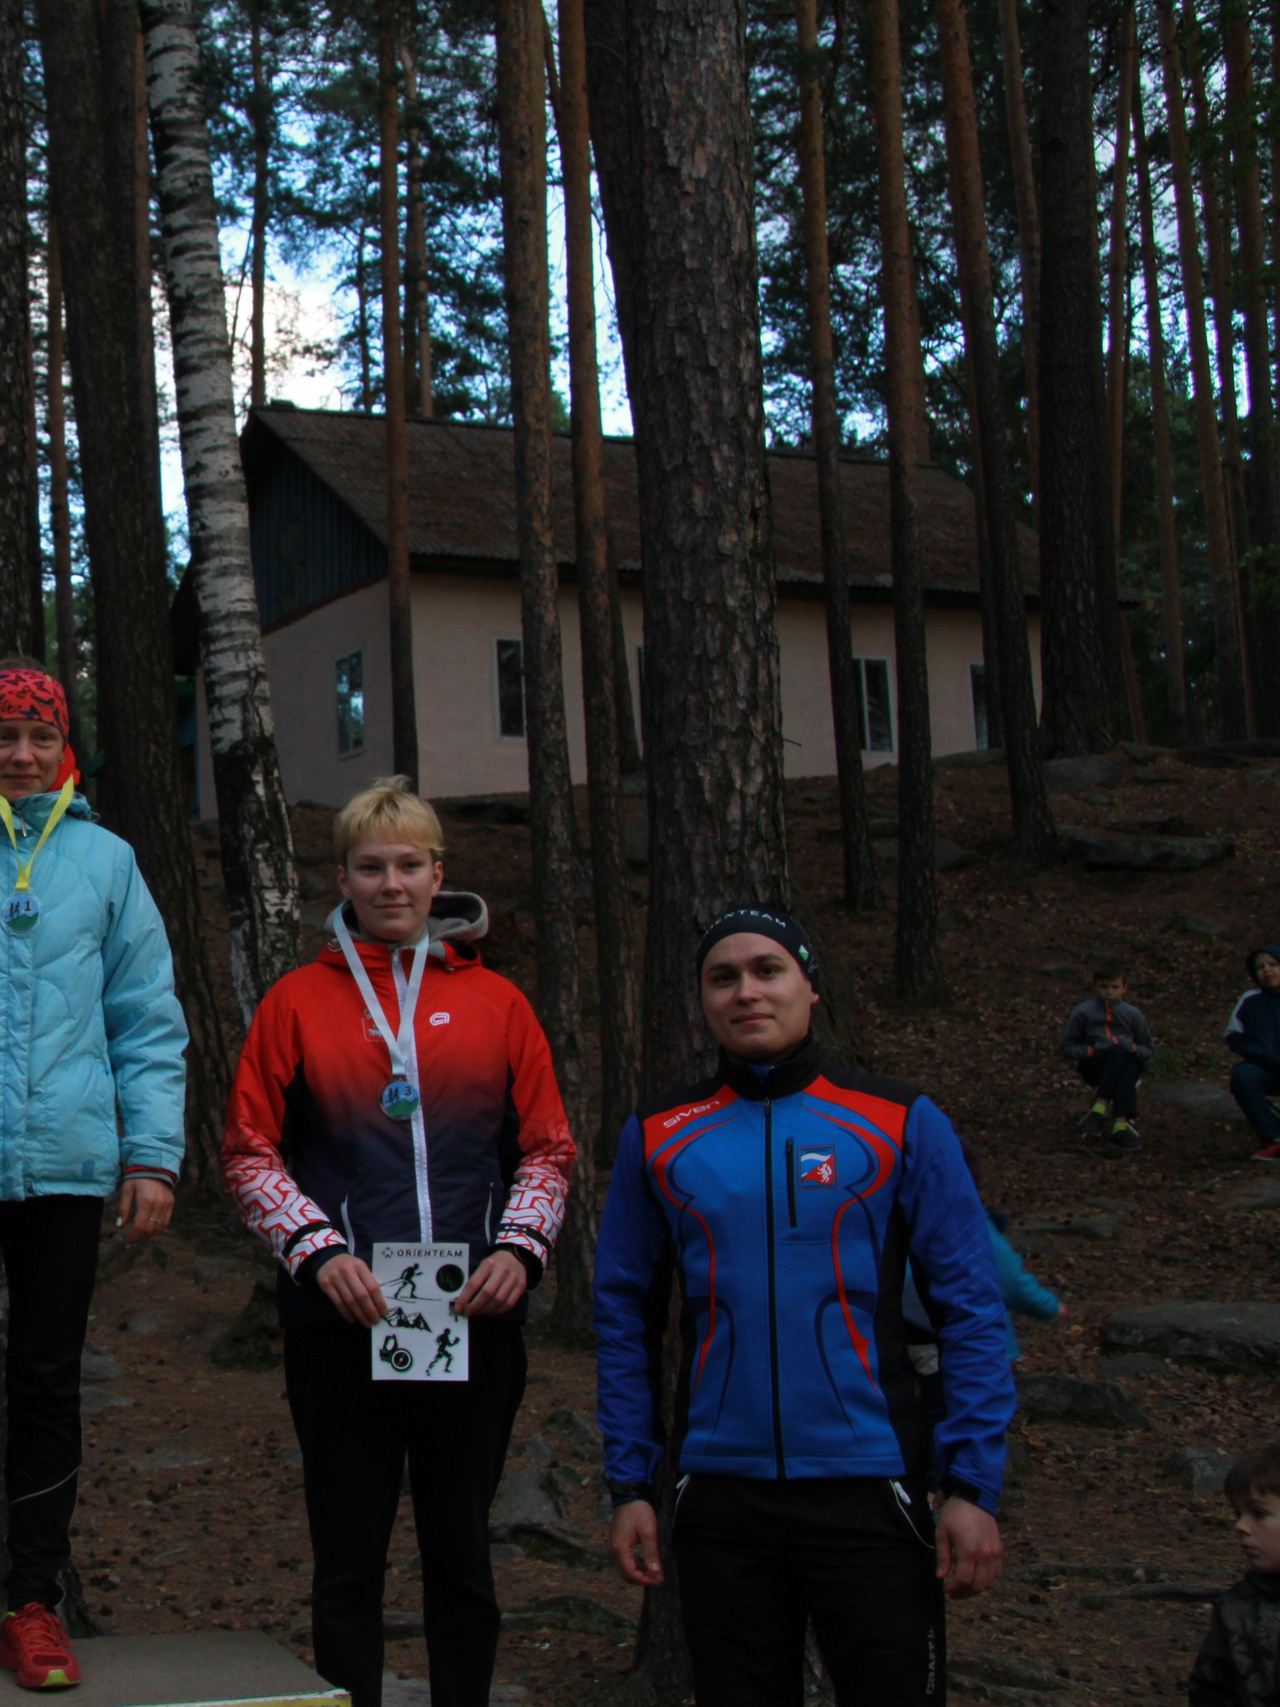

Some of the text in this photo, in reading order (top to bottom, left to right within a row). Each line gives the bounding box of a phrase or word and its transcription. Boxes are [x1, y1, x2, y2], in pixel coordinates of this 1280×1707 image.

[24, 901, 31, 911] 1
[404, 1086, 412, 1096] 3
[396, 1249, 462, 1258] ORIENTEAM
